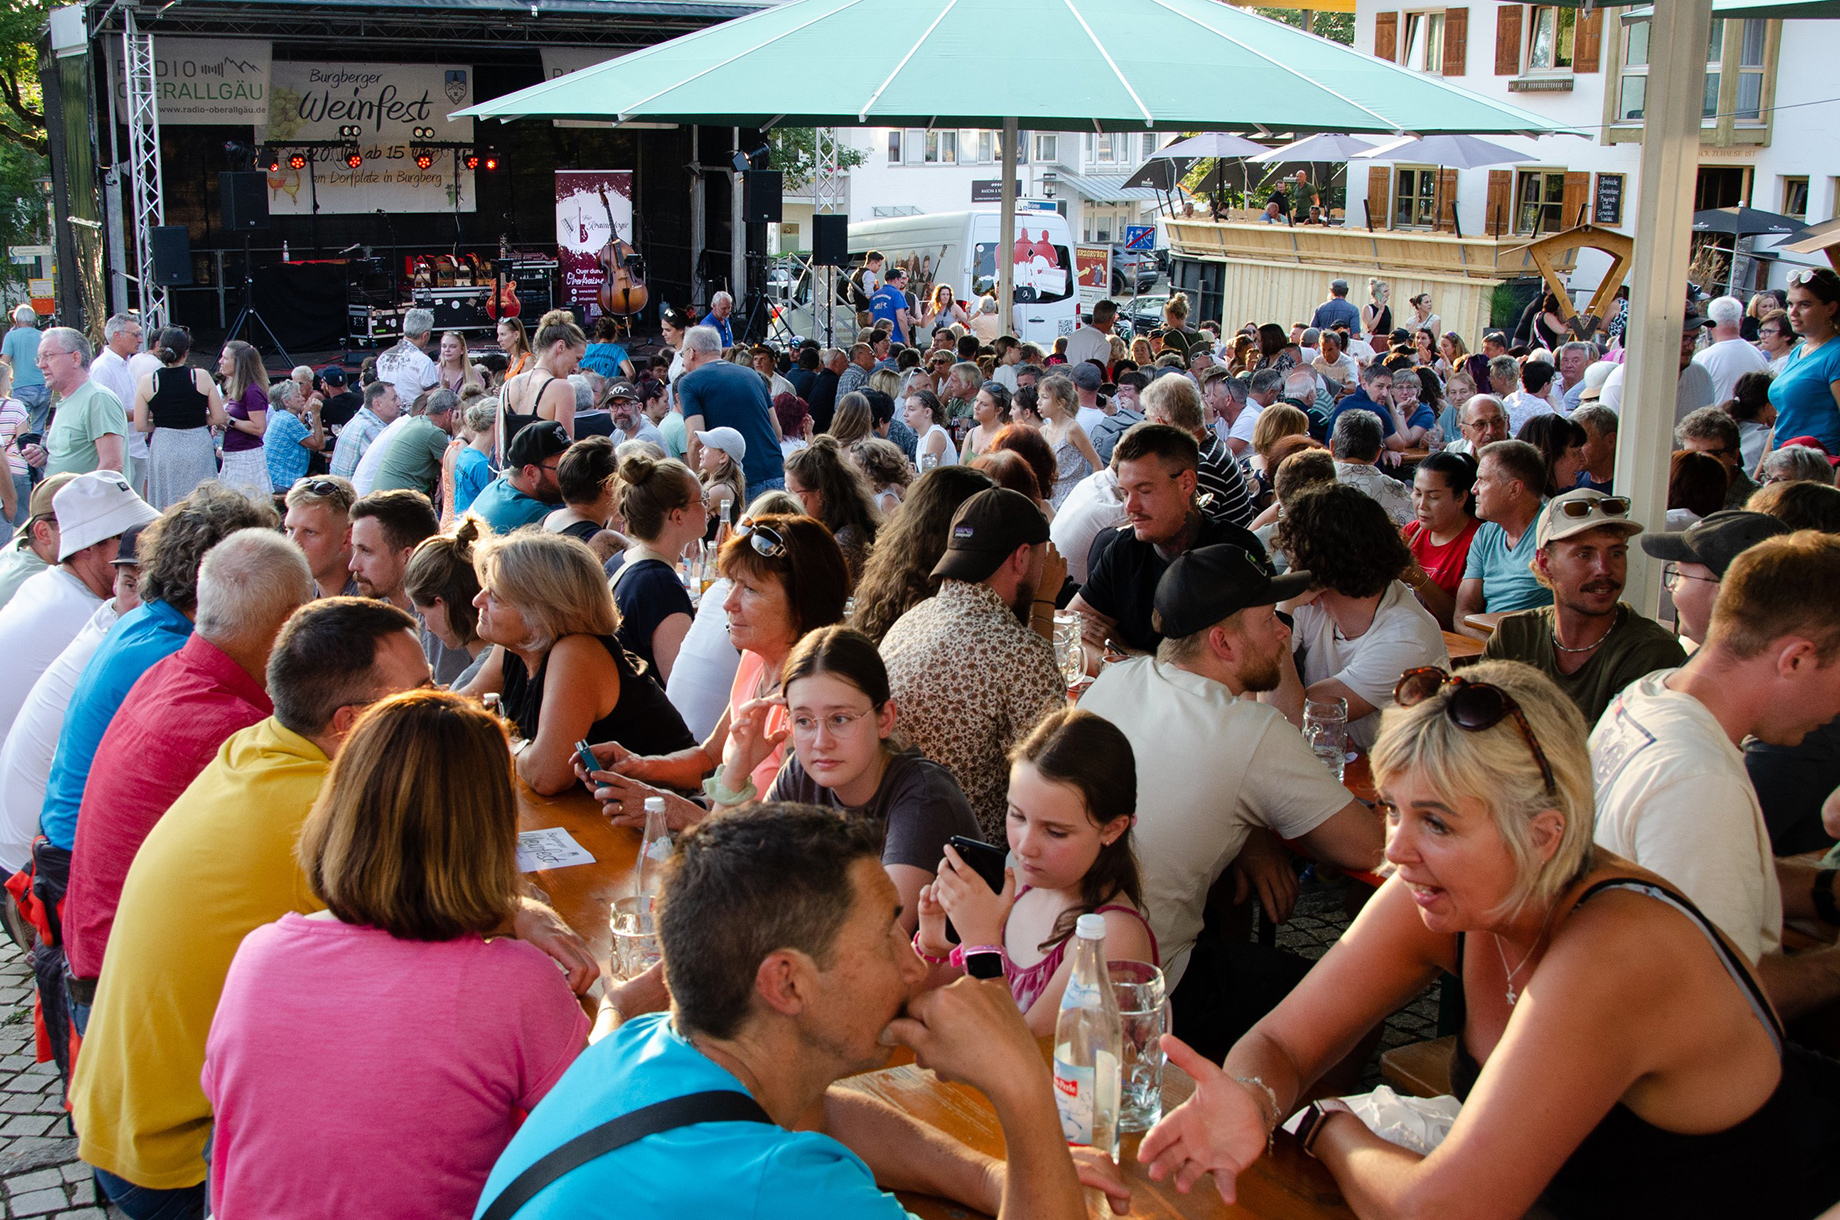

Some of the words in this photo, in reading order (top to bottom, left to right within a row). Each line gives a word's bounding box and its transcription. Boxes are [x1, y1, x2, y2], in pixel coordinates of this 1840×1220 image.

[309, 69, 383, 89] Burgberger
[159, 106, 266, 114] www.radio-oberallgäu.de
[298, 85, 434, 132] Weinfest
[364, 144, 382, 160] ab
[386, 145, 405, 159] 15
[330, 170, 379, 188] Dorfplatz
[383, 170, 392, 183] in
[396, 170, 442, 188] Burgberg
